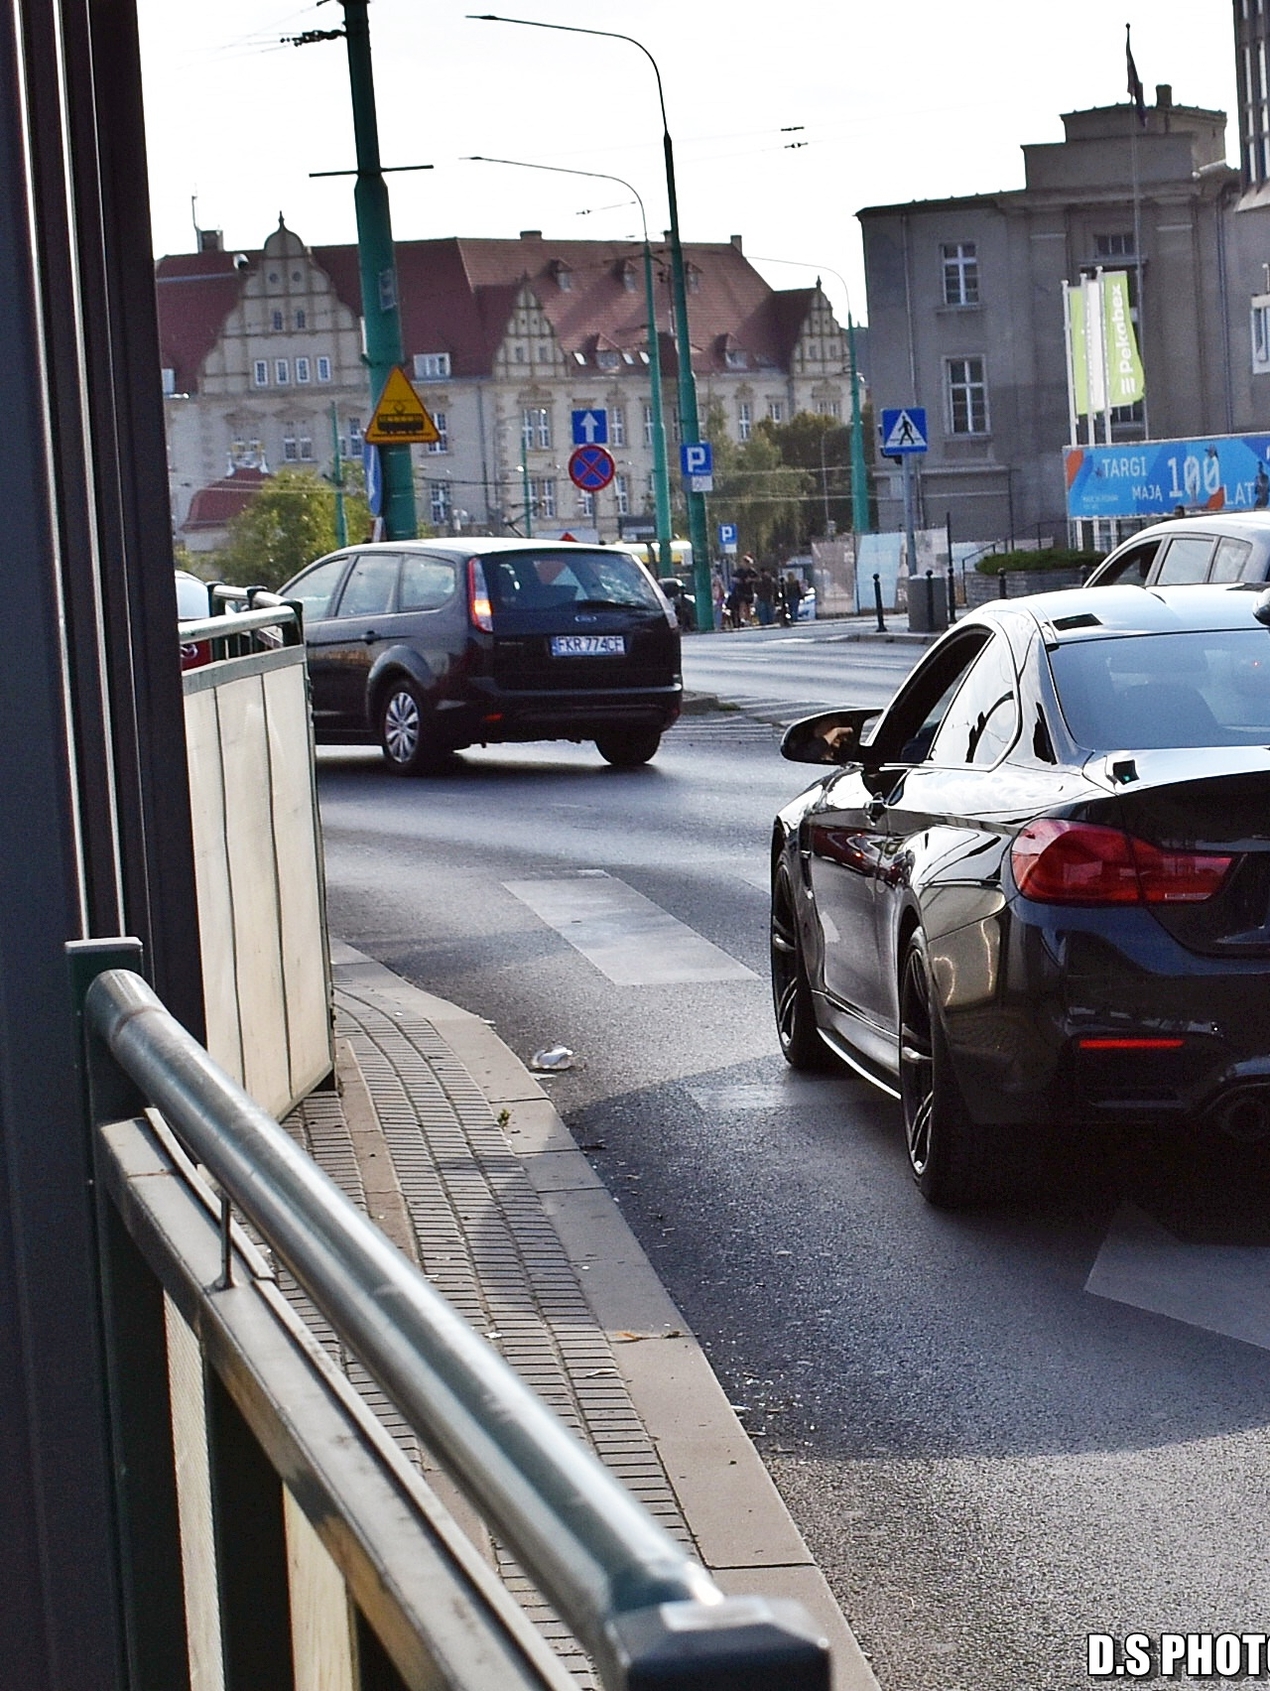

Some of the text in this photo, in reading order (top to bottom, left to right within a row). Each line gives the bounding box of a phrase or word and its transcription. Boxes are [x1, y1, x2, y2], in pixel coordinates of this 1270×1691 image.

[1111, 284, 1134, 374] Pekabex
[687, 446, 706, 473] P
[1102, 457, 1147, 478] TARGI
[1167, 455, 1221, 499] 100
[1132, 486, 1163, 503] MAJĄ
[1224, 481, 1255, 506] LAT
